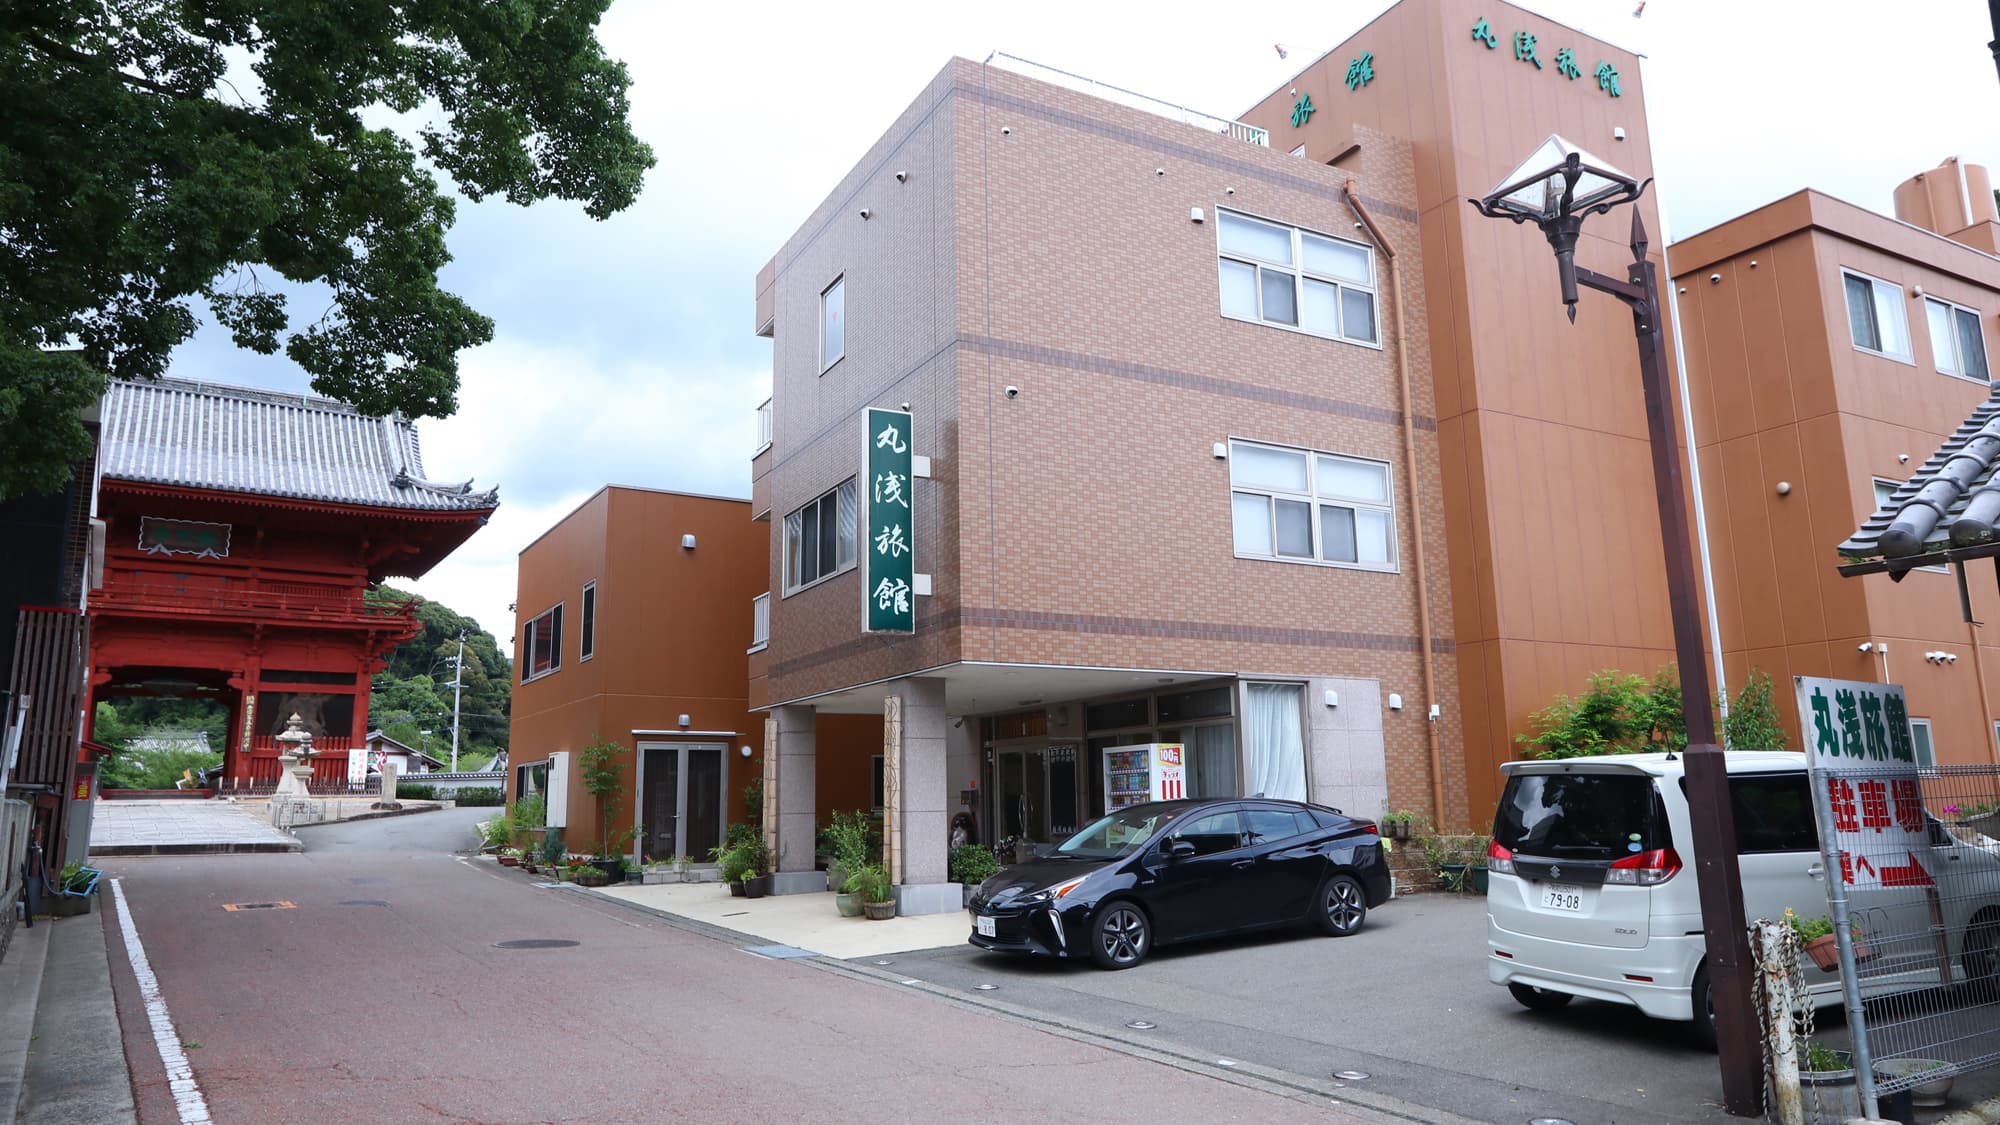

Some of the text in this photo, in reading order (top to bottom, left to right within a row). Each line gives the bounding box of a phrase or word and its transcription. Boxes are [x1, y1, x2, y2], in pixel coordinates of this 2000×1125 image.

[1471, 16, 1623, 97] 丸浅旅館
[873, 423, 911, 616] 丸浅旅館
[1810, 686, 1914, 763] 丸浅旅館
[1827, 776, 1924, 834] 駐車場
[1550, 893, 1580, 909] 79-08
